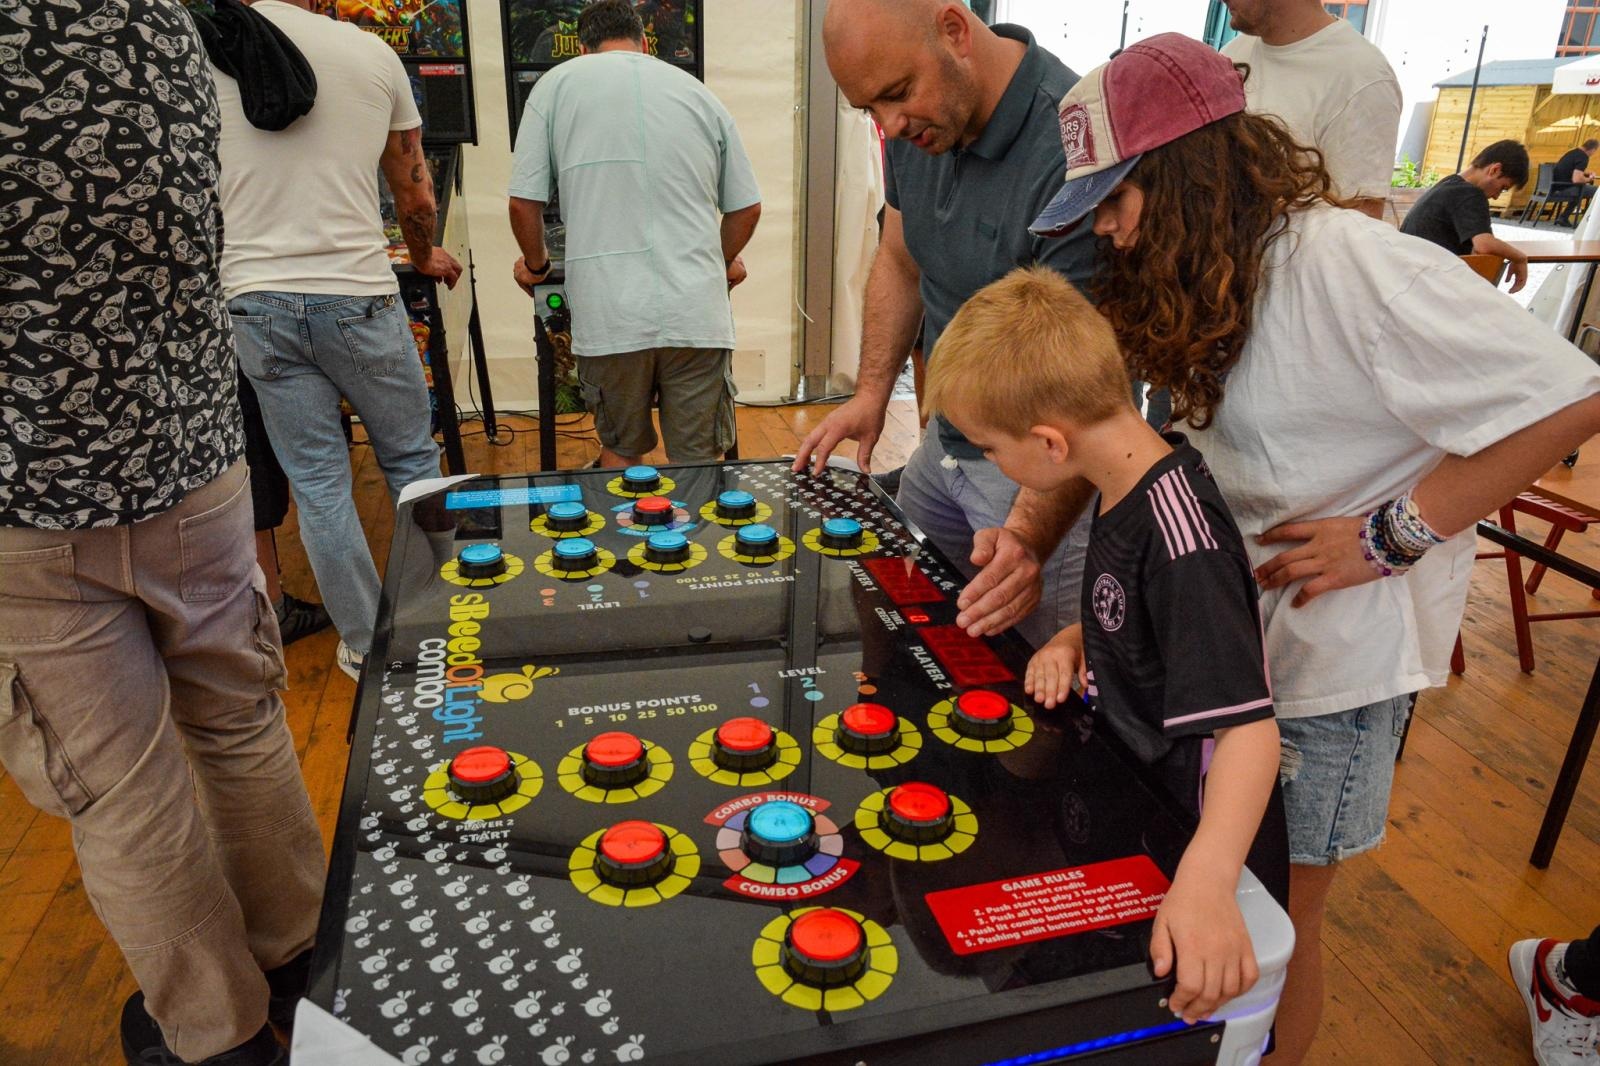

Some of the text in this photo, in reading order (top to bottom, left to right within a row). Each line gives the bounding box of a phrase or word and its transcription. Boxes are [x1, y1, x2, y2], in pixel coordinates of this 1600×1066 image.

[45, 11, 57, 31] GIZMO
[41, 59, 64, 75] GIZMO
[38, 134, 62, 152] GIZMO
[86, 182, 96, 203] GIZMO
[75, 232, 97, 251] GIZMO
[70, 306, 89, 325] GIZMO
[9, 353, 35, 369] GIZMO
[689, 575, 795, 590] BONUS POINTS
[846, 560, 875, 587] PLAYER
[577, 601, 621, 611] LEVEL
[875, 607, 898, 631] CREDITS
[888, 609, 905, 625] TIME
[413, 638, 451, 708] combo
[778, 667, 827, 678] LEVEL
[909, 645, 952, 690] PLAYER 2
[747, 671, 868, 693] 1 2 3
[555, 703, 718, 728] 1 5 10 25 50 100
[568, 694, 702, 716] BONUS POINTS
[714, 794, 818, 820] COMBO BONUS
[455, 818, 514, 832] PLAYER 2
[459, 829, 511, 843] START
[739, 867, 848, 896] COMBO BONUS
[1001, 869, 1085, 892] GAME RULES
[1012, 881, 1087, 900] 1. Insert credits
[973, 908, 985, 916] 2.
[985, 903, 1012, 914] Push
[1012, 899, 1037, 909] start
[1051, 893, 1072, 903] play
[1081, 885, 1106, 896] level
[1106, 881, 1134, 893] game
[977, 917, 989, 925] 3.
[989, 912, 1016, 923] Push
[1017, 909, 1030, 918] all
[1030, 907, 1043, 915] lit
[1043, 901, 1083, 913] buttons
[1097, 894, 1115, 904] get
[1115, 888, 1142, 900] point
[956, 930, 968, 939] 4.
[968, 926, 996, 936] Push
[995, 923, 1009, 932] lit
[1010, 917, 1045, 929] combo
[1045, 910, 1082, 921] button
[1095, 903, 1113, 914] get
[1113, 899, 1140, 908] extra
[964, 939, 977, 947] 5.
[977, 932, 1021, 945] Pushing
[1021, 926, 1047, 936] unlit
[1047, 919, 1088, 931] buttons
[1088, 913, 1116, 923] takes
[1116, 907, 1148, 919] points
